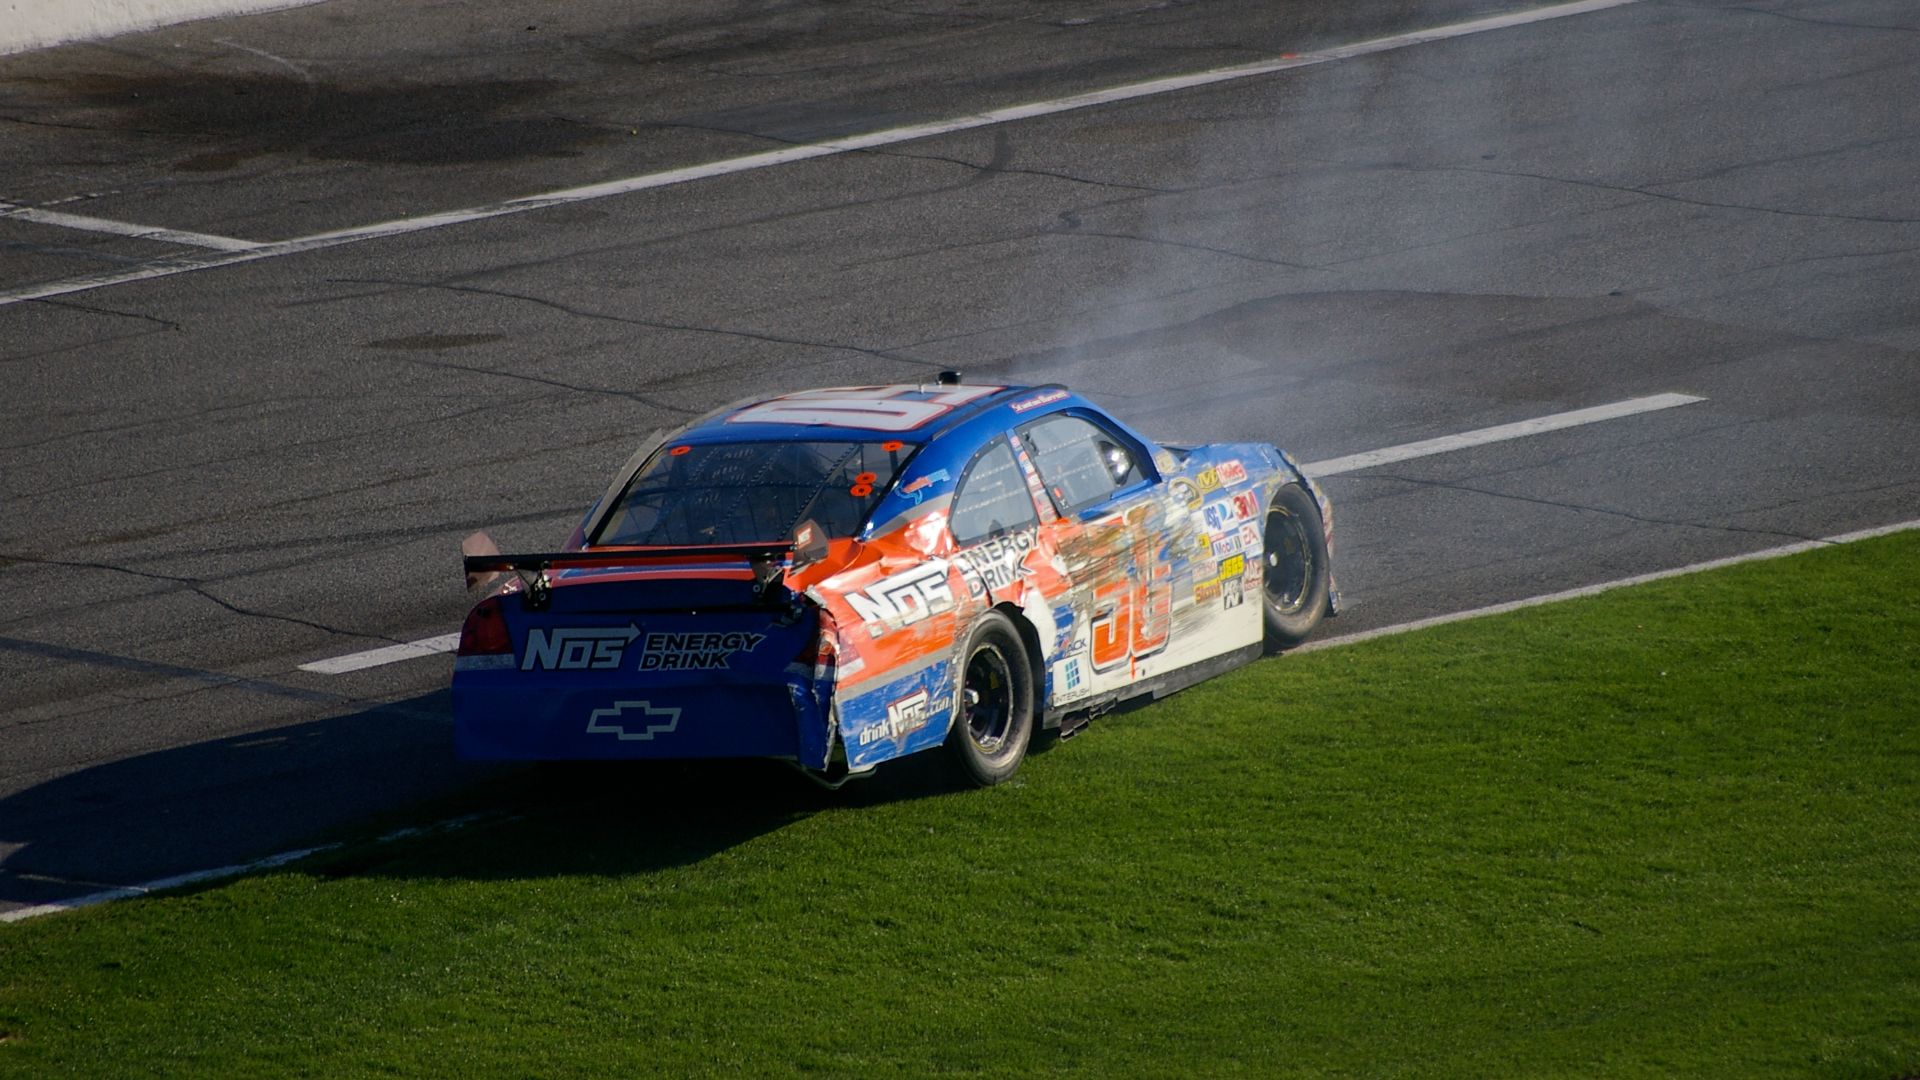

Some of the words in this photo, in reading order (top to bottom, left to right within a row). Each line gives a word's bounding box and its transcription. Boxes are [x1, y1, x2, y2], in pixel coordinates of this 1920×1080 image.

[843, 554, 955, 640] NOS
[521, 622, 641, 671] NOS
[646, 632, 767, 652] ENERGY
[638, 650, 731, 672] DRINK
